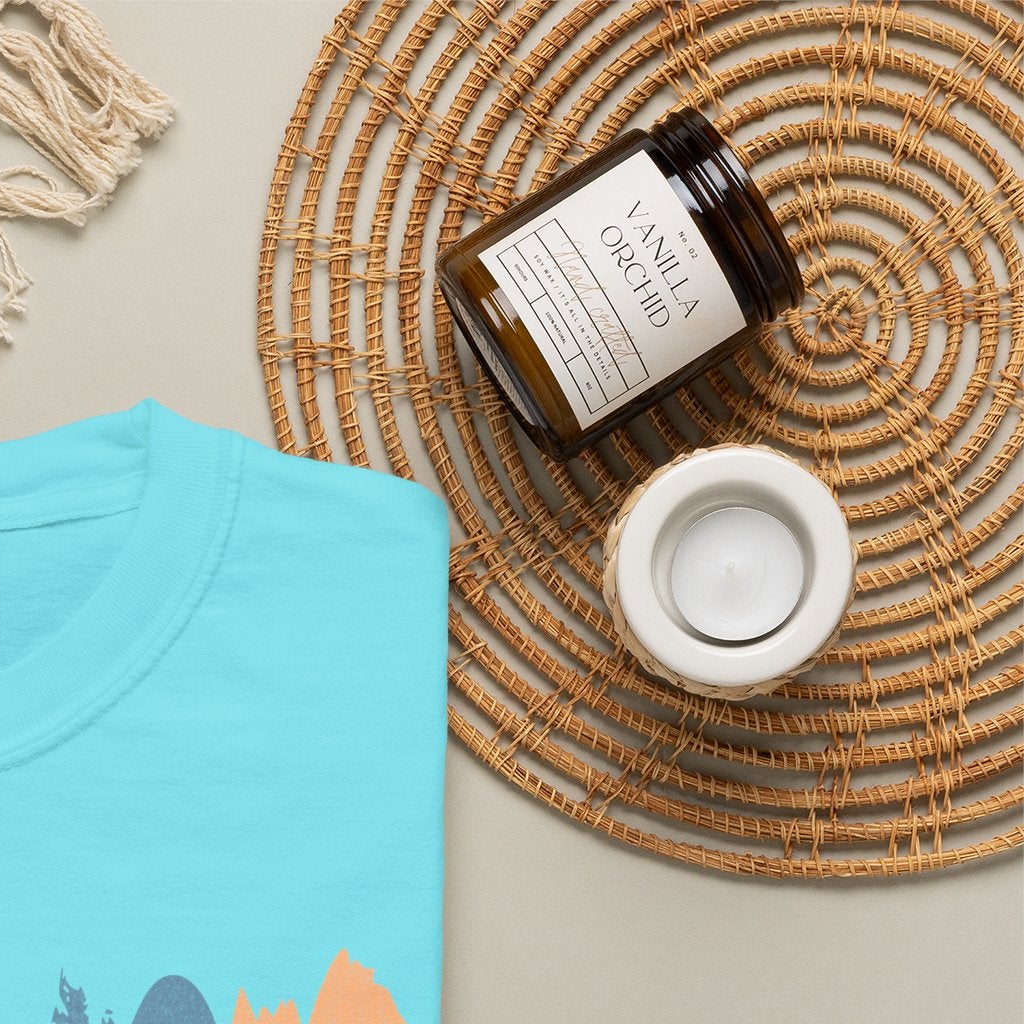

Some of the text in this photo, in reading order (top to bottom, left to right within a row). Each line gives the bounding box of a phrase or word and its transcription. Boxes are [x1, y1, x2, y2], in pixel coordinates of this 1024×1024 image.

[600, 224, 672, 329] ORCHID
[626, 199, 701, 319] VANILLA
[678, 230, 699, 260] No. 02
[533, 254, 544, 267] SOY
[543, 269, 555, 283] WAX
[557, 291, 570, 306] IT'S
[569, 309, 579, 322] ALL
[578, 324, 586, 334] IN
[584, 335, 596, 349] THE
[593, 351, 611, 380] DETAILS
[553, 324, 567, 345] NATURAL
